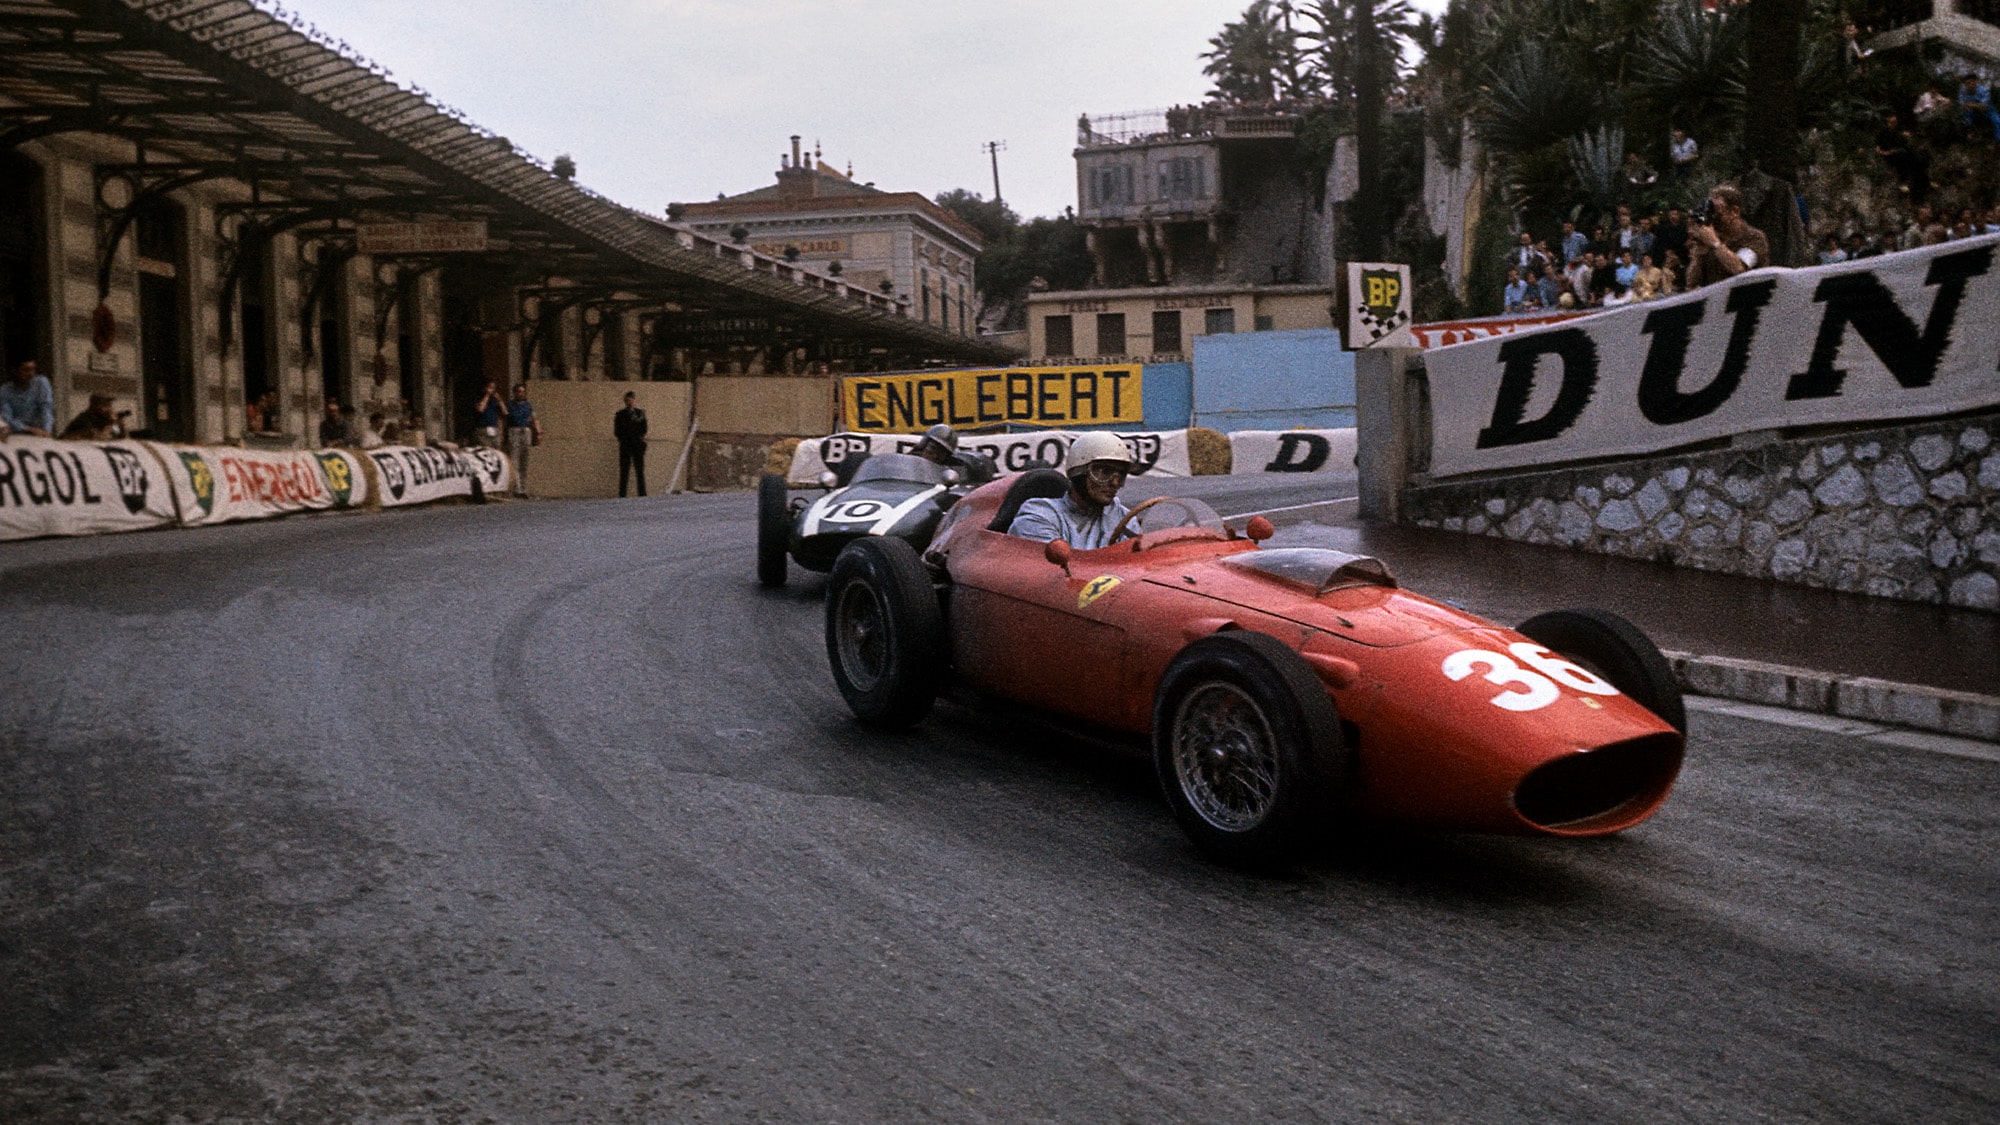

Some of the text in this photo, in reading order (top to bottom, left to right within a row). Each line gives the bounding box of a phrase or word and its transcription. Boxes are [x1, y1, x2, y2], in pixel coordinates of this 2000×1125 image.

[1367, 277, 1400, 307] BP
[1476, 244, 2000, 449] DUN
[826, 438, 867, 463] BP
[1265, 433, 1357, 472] D
[824, 502, 881, 518] 10
[1442, 641, 1622, 712] 36
